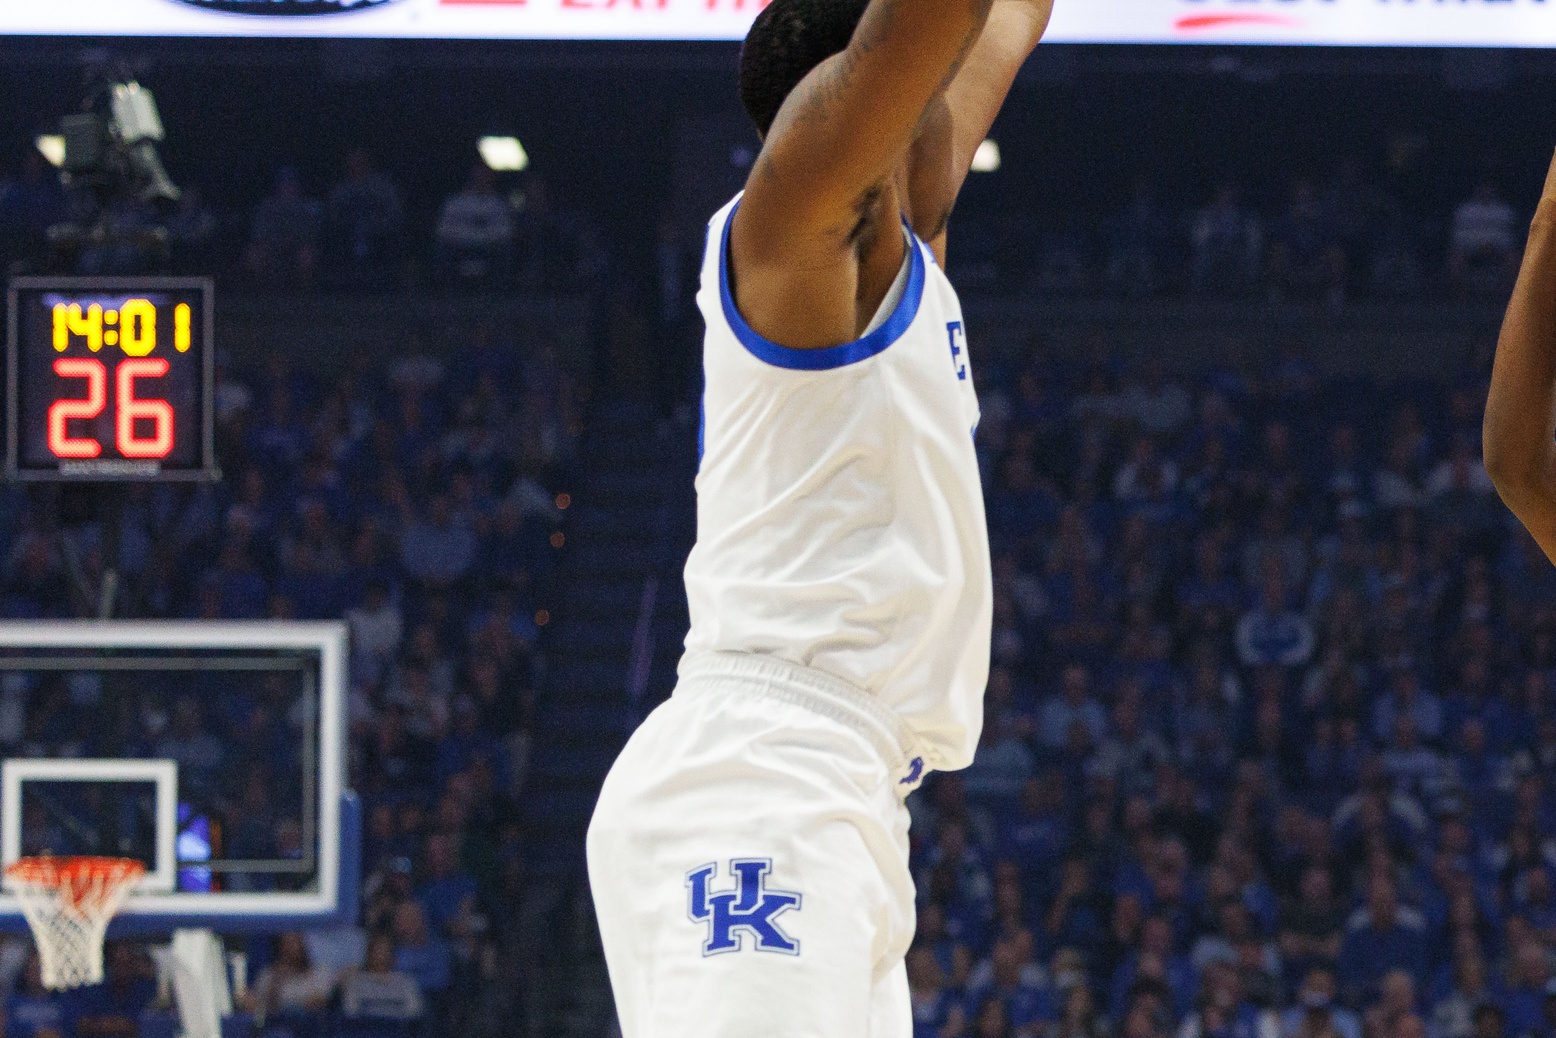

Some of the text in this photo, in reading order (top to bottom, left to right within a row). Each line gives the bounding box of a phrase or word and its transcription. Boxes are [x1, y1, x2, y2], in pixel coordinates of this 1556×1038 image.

[52, 298, 191, 357] 14:01
[47, 357, 175, 459] 26
[685, 857, 803, 958] UK
